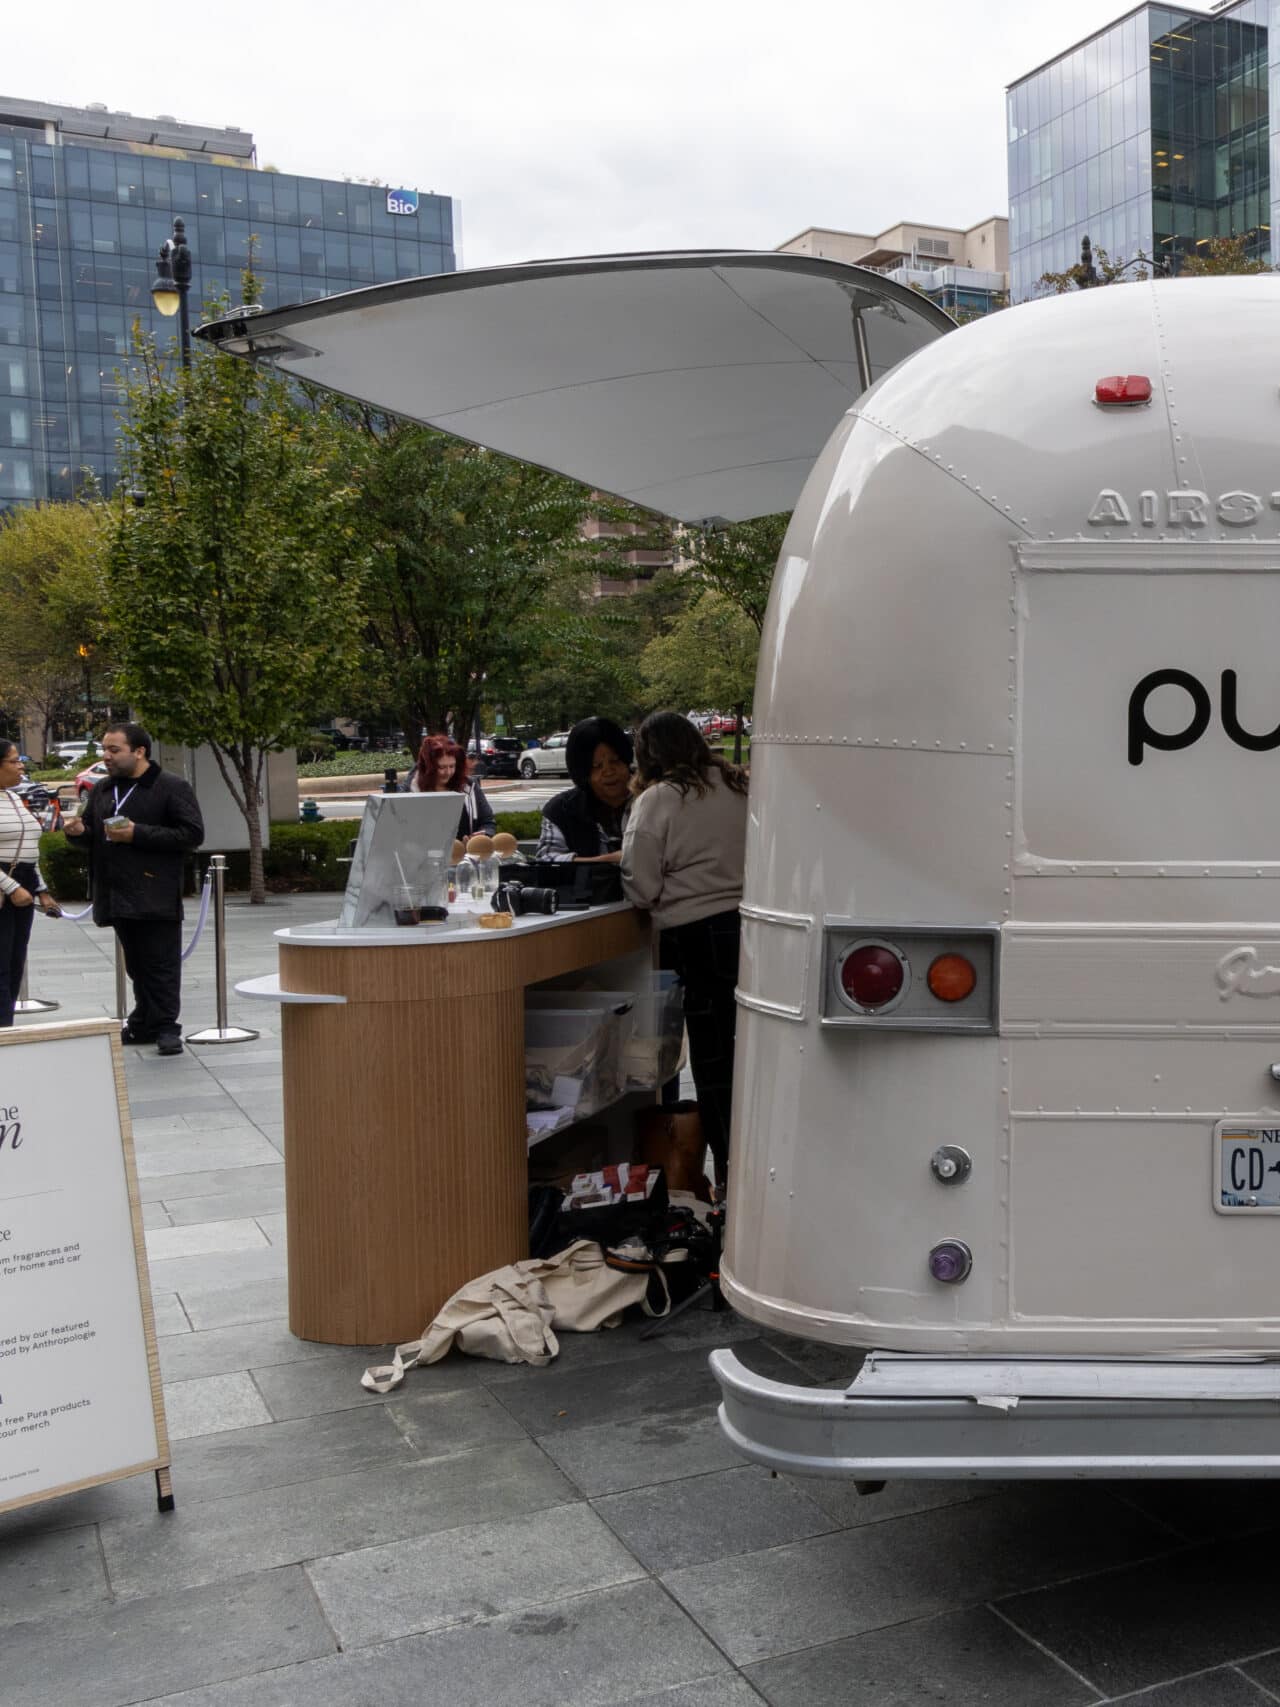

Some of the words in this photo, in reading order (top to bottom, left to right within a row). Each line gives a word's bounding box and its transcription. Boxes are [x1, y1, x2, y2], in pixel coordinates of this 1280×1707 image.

[388, 199, 415, 214] Bio
[1230, 1147, 1265, 1191] CD
[13, 1247, 61, 1262] fragrances
[63, 1242, 80, 1253] and
[4, 1267, 17, 1275] for
[20, 1261, 46, 1272] home
[48, 1256, 65, 1266] and
[67, 1254, 82, 1263] car
[19, 1345, 30, 1353] by
[33, 1330, 96, 1350] Anthropologie
[20, 1334, 31, 1342] by
[33, 1330, 48, 1339] our
[51, 1320, 90, 1335] featured
[5, 1415, 25, 1425] free
[27, 1409, 48, 1419] Pura
[50, 1399, 91, 1416] products
[20, 1420, 50, 1433] merch
